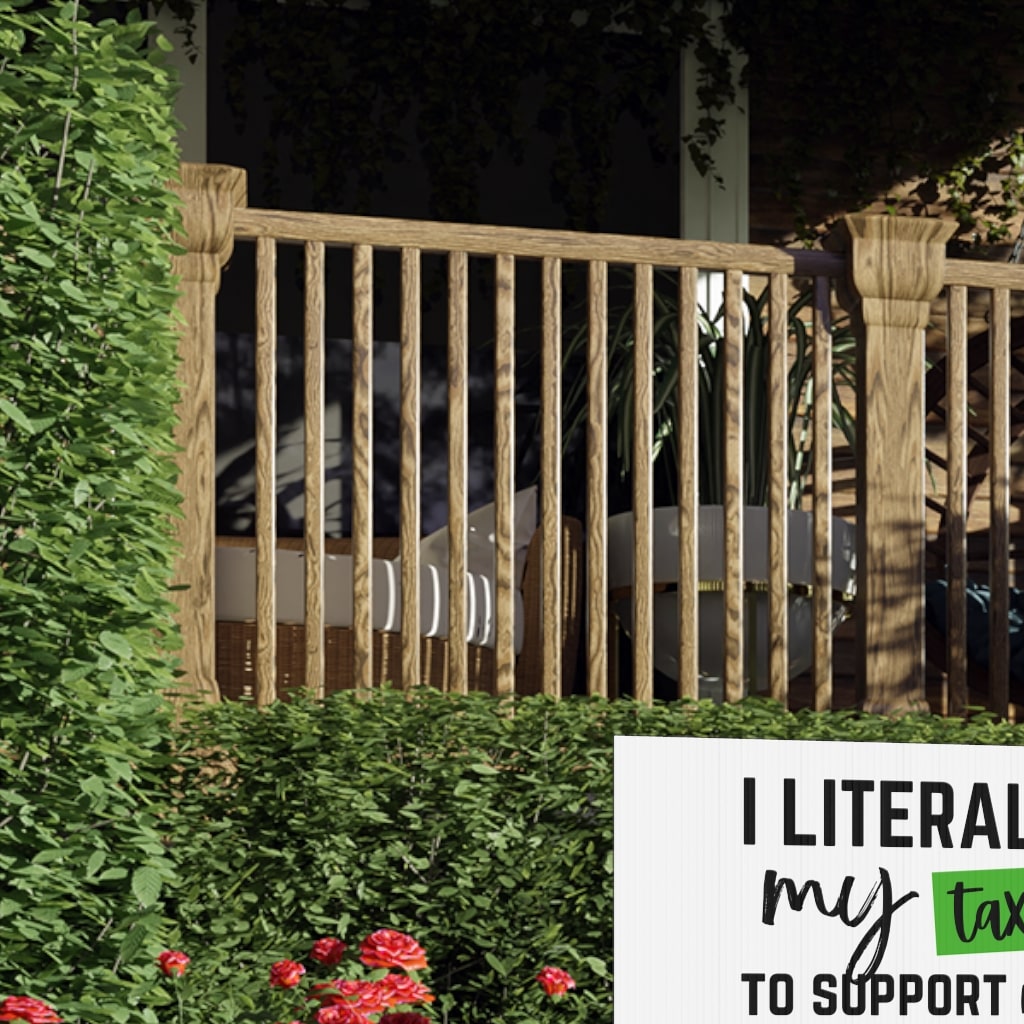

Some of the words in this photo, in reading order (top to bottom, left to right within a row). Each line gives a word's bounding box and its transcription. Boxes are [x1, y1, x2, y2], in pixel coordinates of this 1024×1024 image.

[744, 777, 756, 845] I
[762, 866, 920, 988] my
[741, 973, 794, 1016] TO
[812, 973, 1007, 1016] SUPPORT
